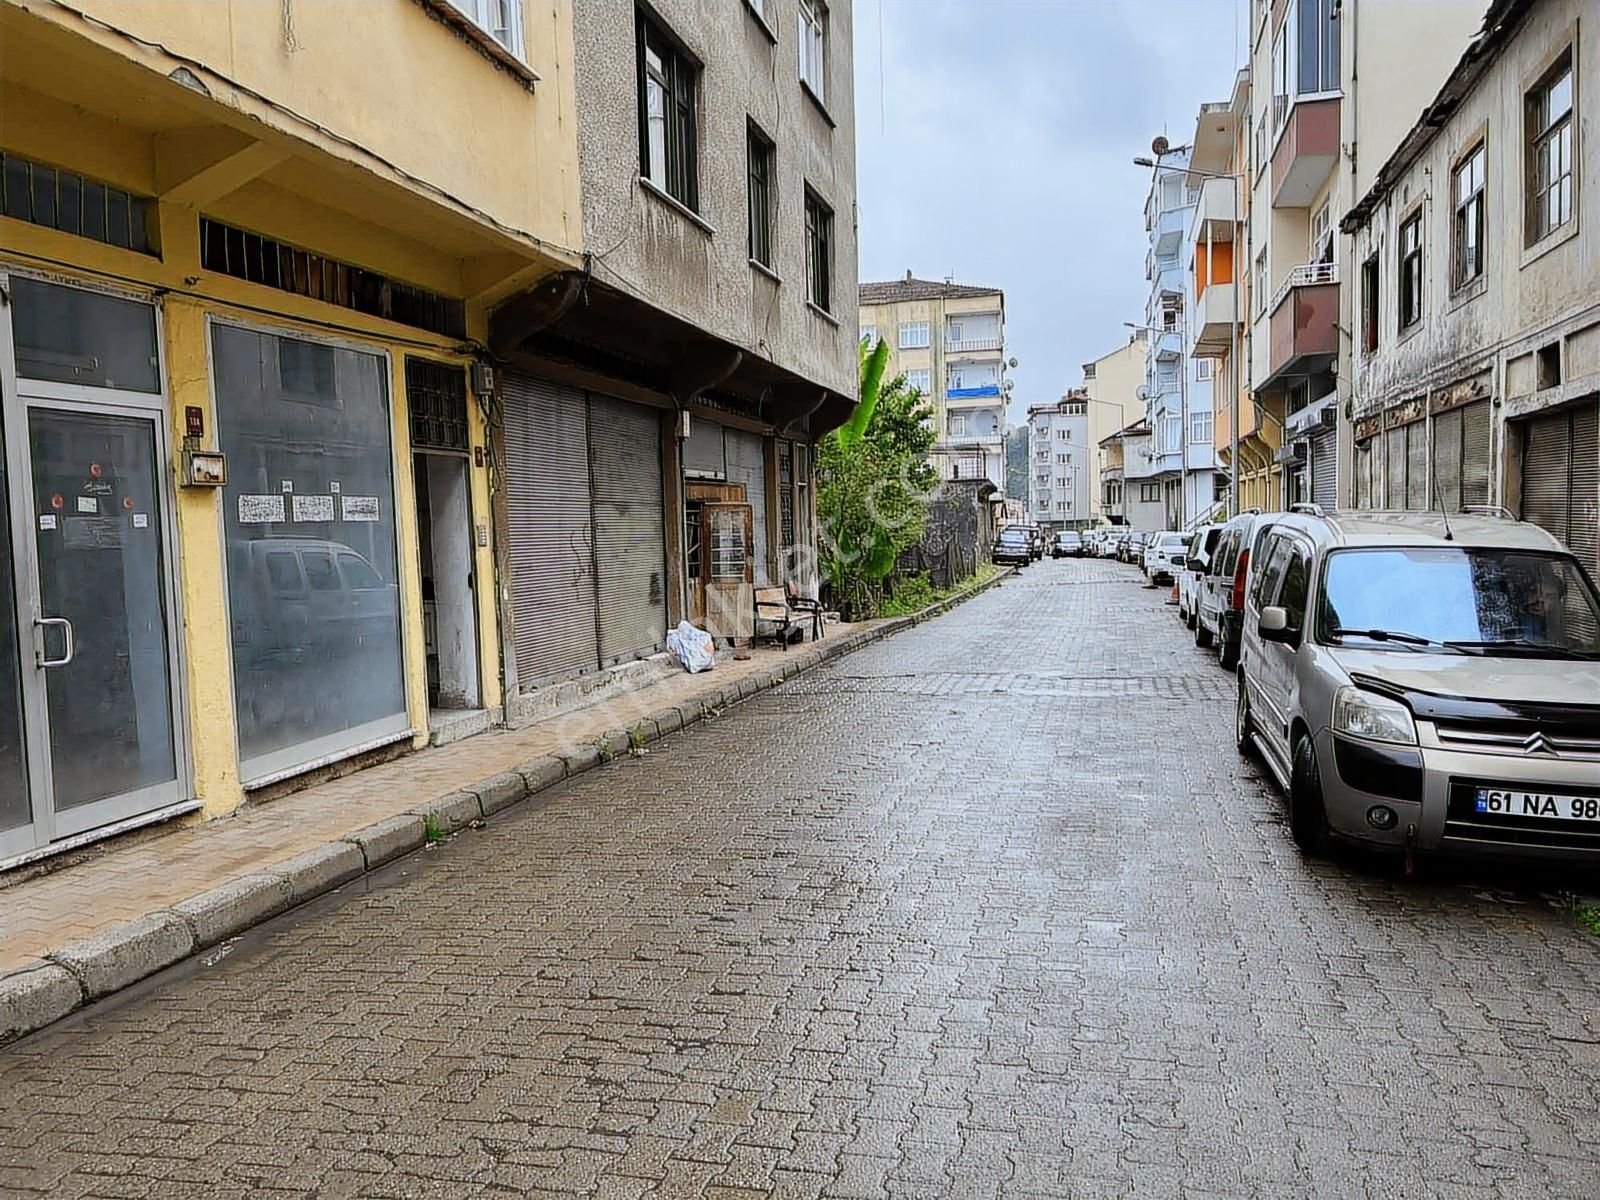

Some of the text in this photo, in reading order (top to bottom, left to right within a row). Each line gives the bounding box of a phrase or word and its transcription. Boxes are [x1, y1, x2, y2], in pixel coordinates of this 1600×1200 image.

[1488, 792, 1512, 812] 61
[1523, 794, 1559, 816] NA
[1571, 798, 1600, 819] 98
